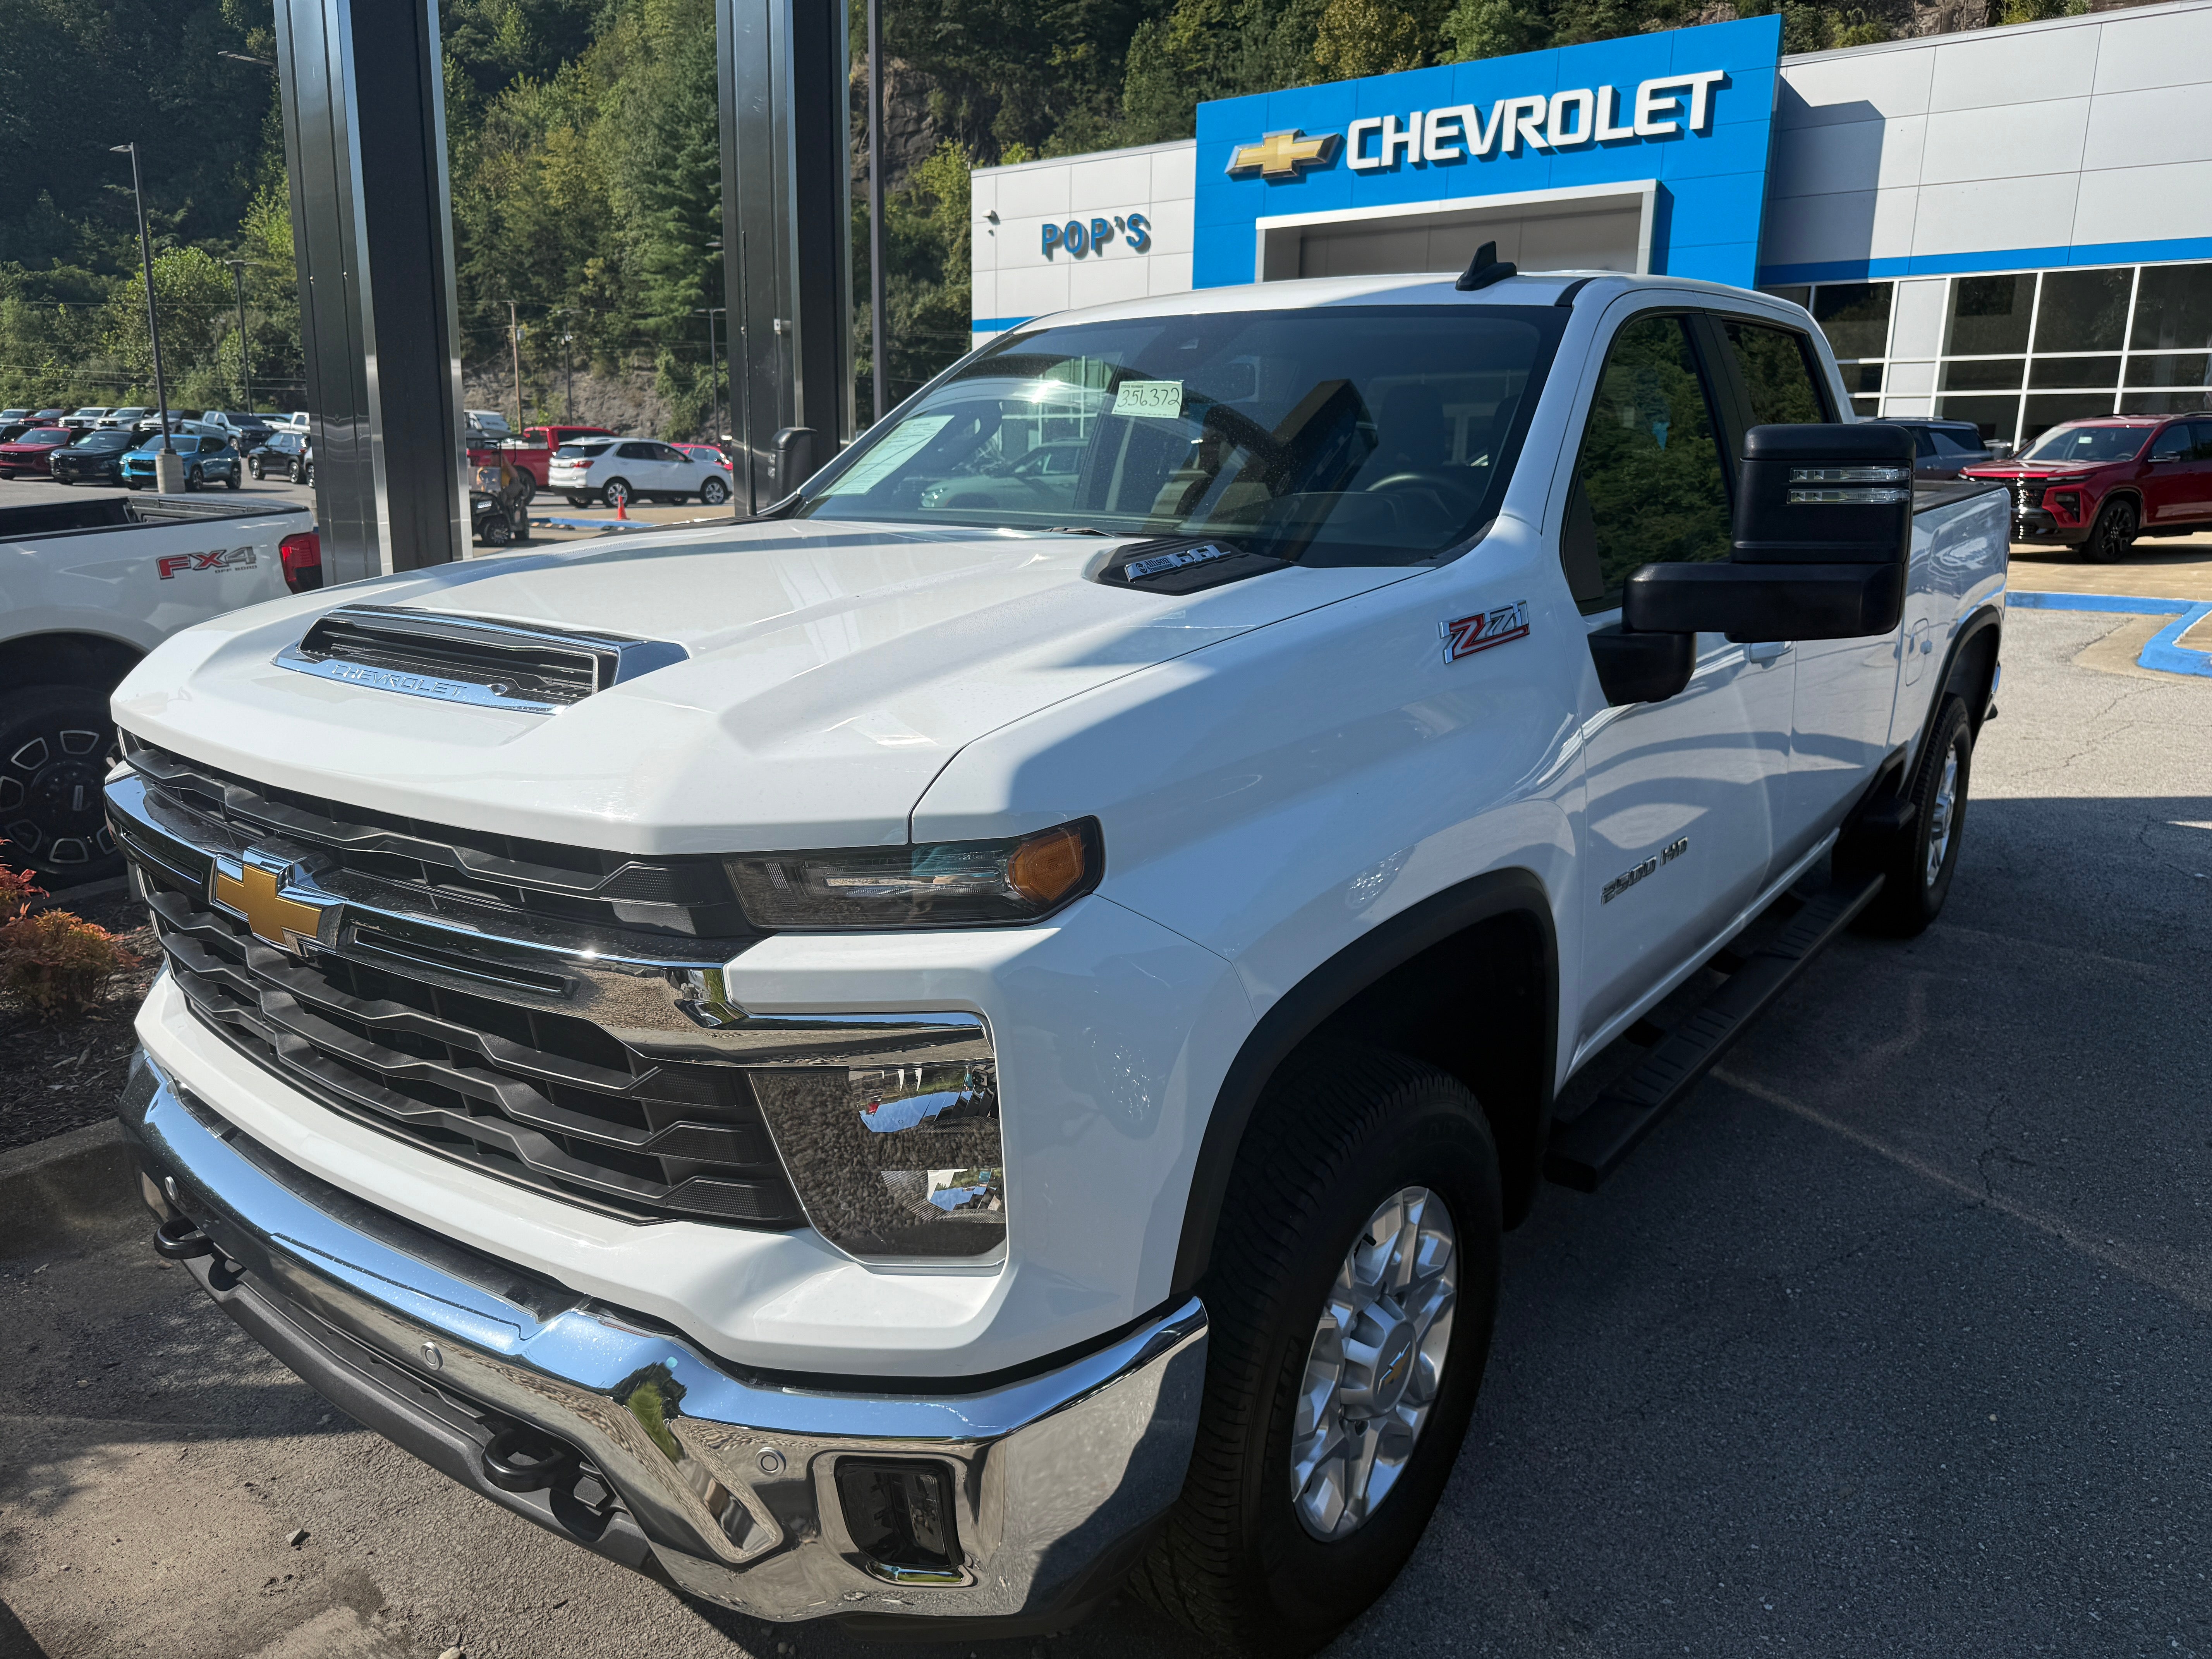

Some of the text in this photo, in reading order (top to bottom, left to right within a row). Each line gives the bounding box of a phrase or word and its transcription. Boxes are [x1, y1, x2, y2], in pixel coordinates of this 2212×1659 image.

[1347, 70, 1723, 170] CHEVROLET
[1042, 213, 1151, 260] POP'S
[1117, 387, 1181, 407] 356372
[156, 546, 257, 580] FX4
[1144, 557, 1170, 568] Allison
[1438, 600, 1530, 664] Z71
[331, 664, 467, 696] CHEVROLET
[1601, 836, 1688, 906] 2500 HD
